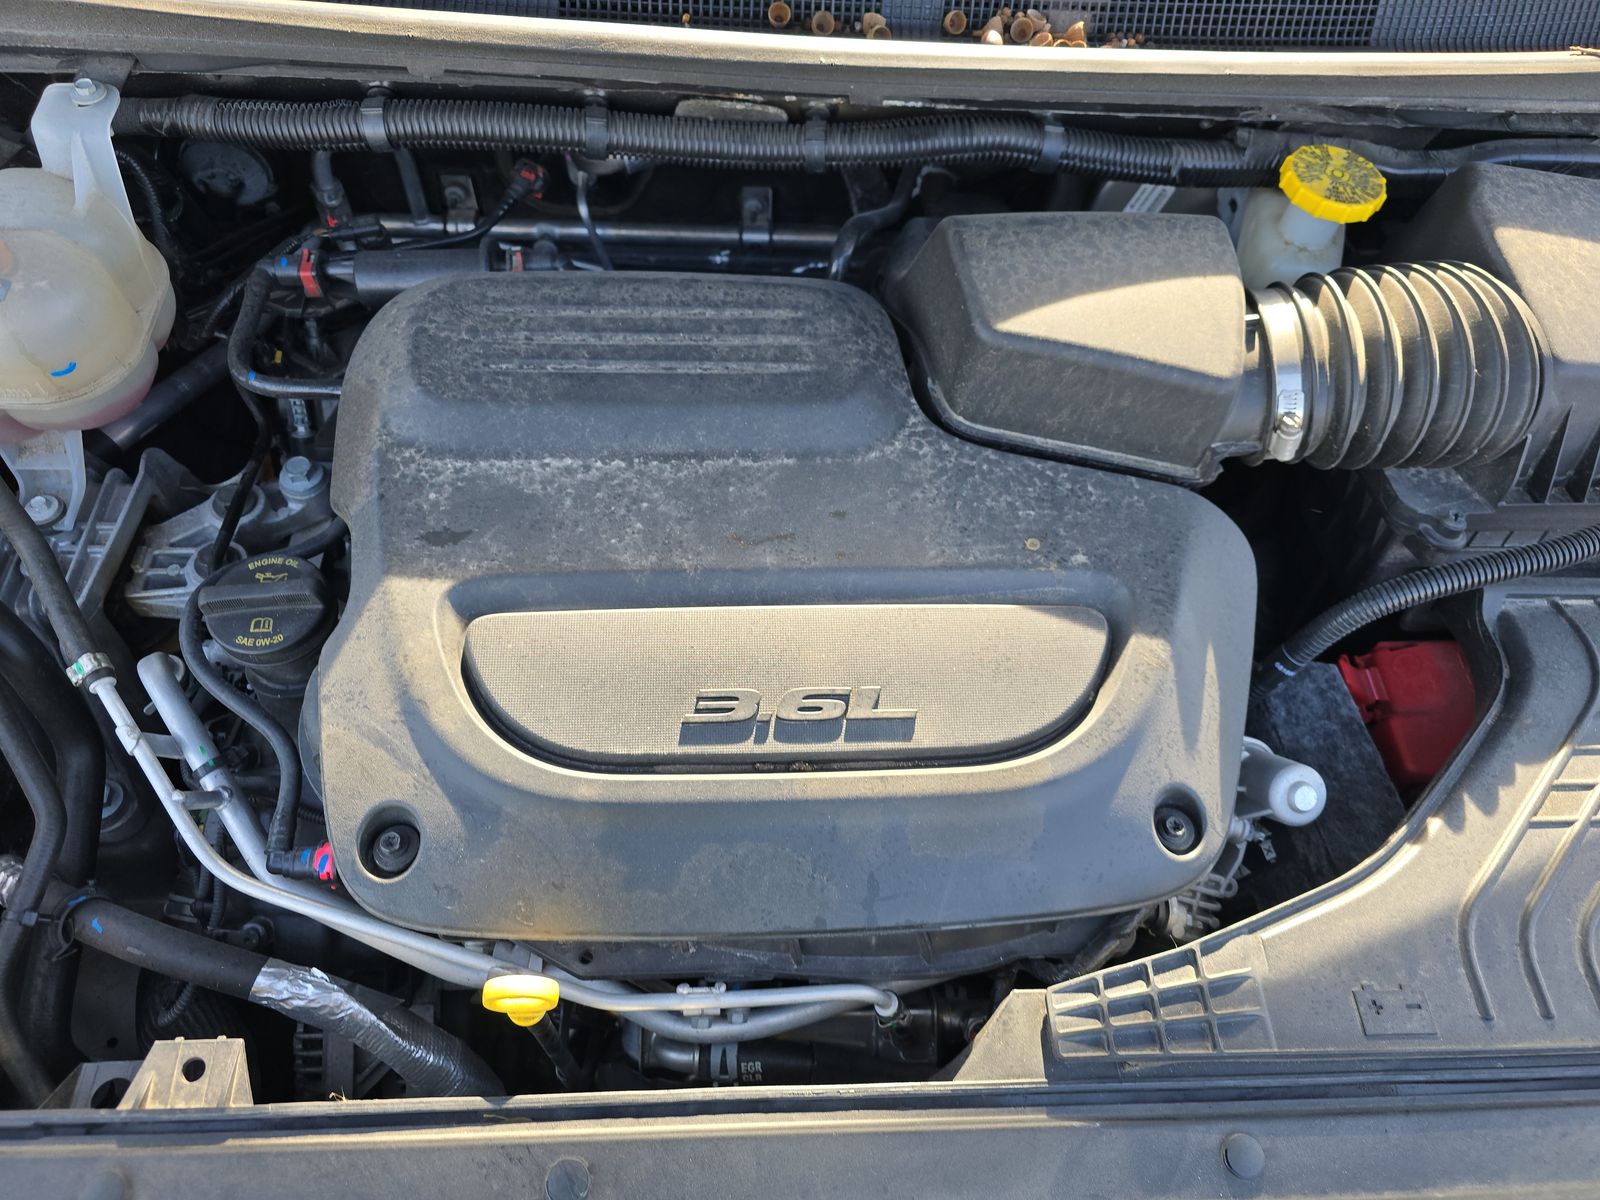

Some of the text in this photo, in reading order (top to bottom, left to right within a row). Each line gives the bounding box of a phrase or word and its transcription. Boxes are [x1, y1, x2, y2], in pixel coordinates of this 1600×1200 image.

[248, 557, 299, 570] ENGINE OIL
[235, 633, 284, 647] SAE 0W-20
[681, 686, 918, 724] 3.6L
[740, 1061, 763, 1074] EGR
